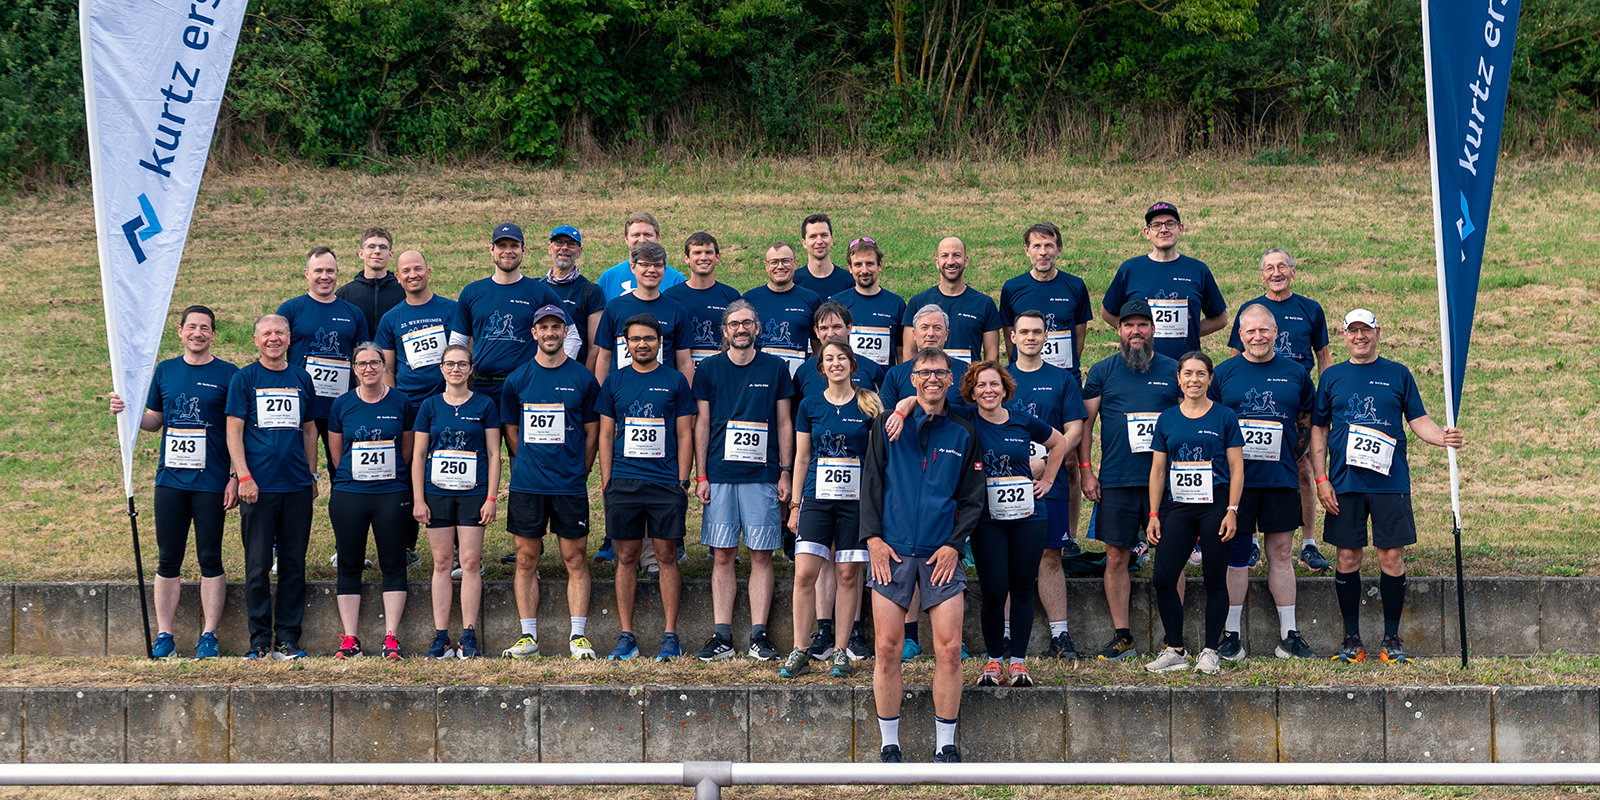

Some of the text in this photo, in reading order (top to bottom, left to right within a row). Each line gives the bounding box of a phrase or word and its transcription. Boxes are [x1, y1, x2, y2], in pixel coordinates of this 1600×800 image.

[1459, 0, 1508, 176] kurtz er
[139, 61, 200, 178] kurtz
[1155, 310, 1179, 322] 251
[412, 337, 438, 353] 255
[857, 337, 882, 350] 229
[1040, 341, 1059, 355] 31
[313, 368, 339, 382] 272
[266, 399, 292, 412] 270
[530, 414, 555, 428] 267
[631, 429, 657, 442] 238
[1136, 423, 1154, 436] 24
[733, 432, 760, 446] 239
[1245, 430, 1272, 445] 233
[171, 439, 196, 453] 243
[1354, 437, 1381, 455] 235
[360, 451, 385, 465] 241
[440, 461, 467, 475] 250
[824, 469, 851, 483] 265
[1176, 473, 1203, 487] 258
[996, 487, 1025, 503] 232
